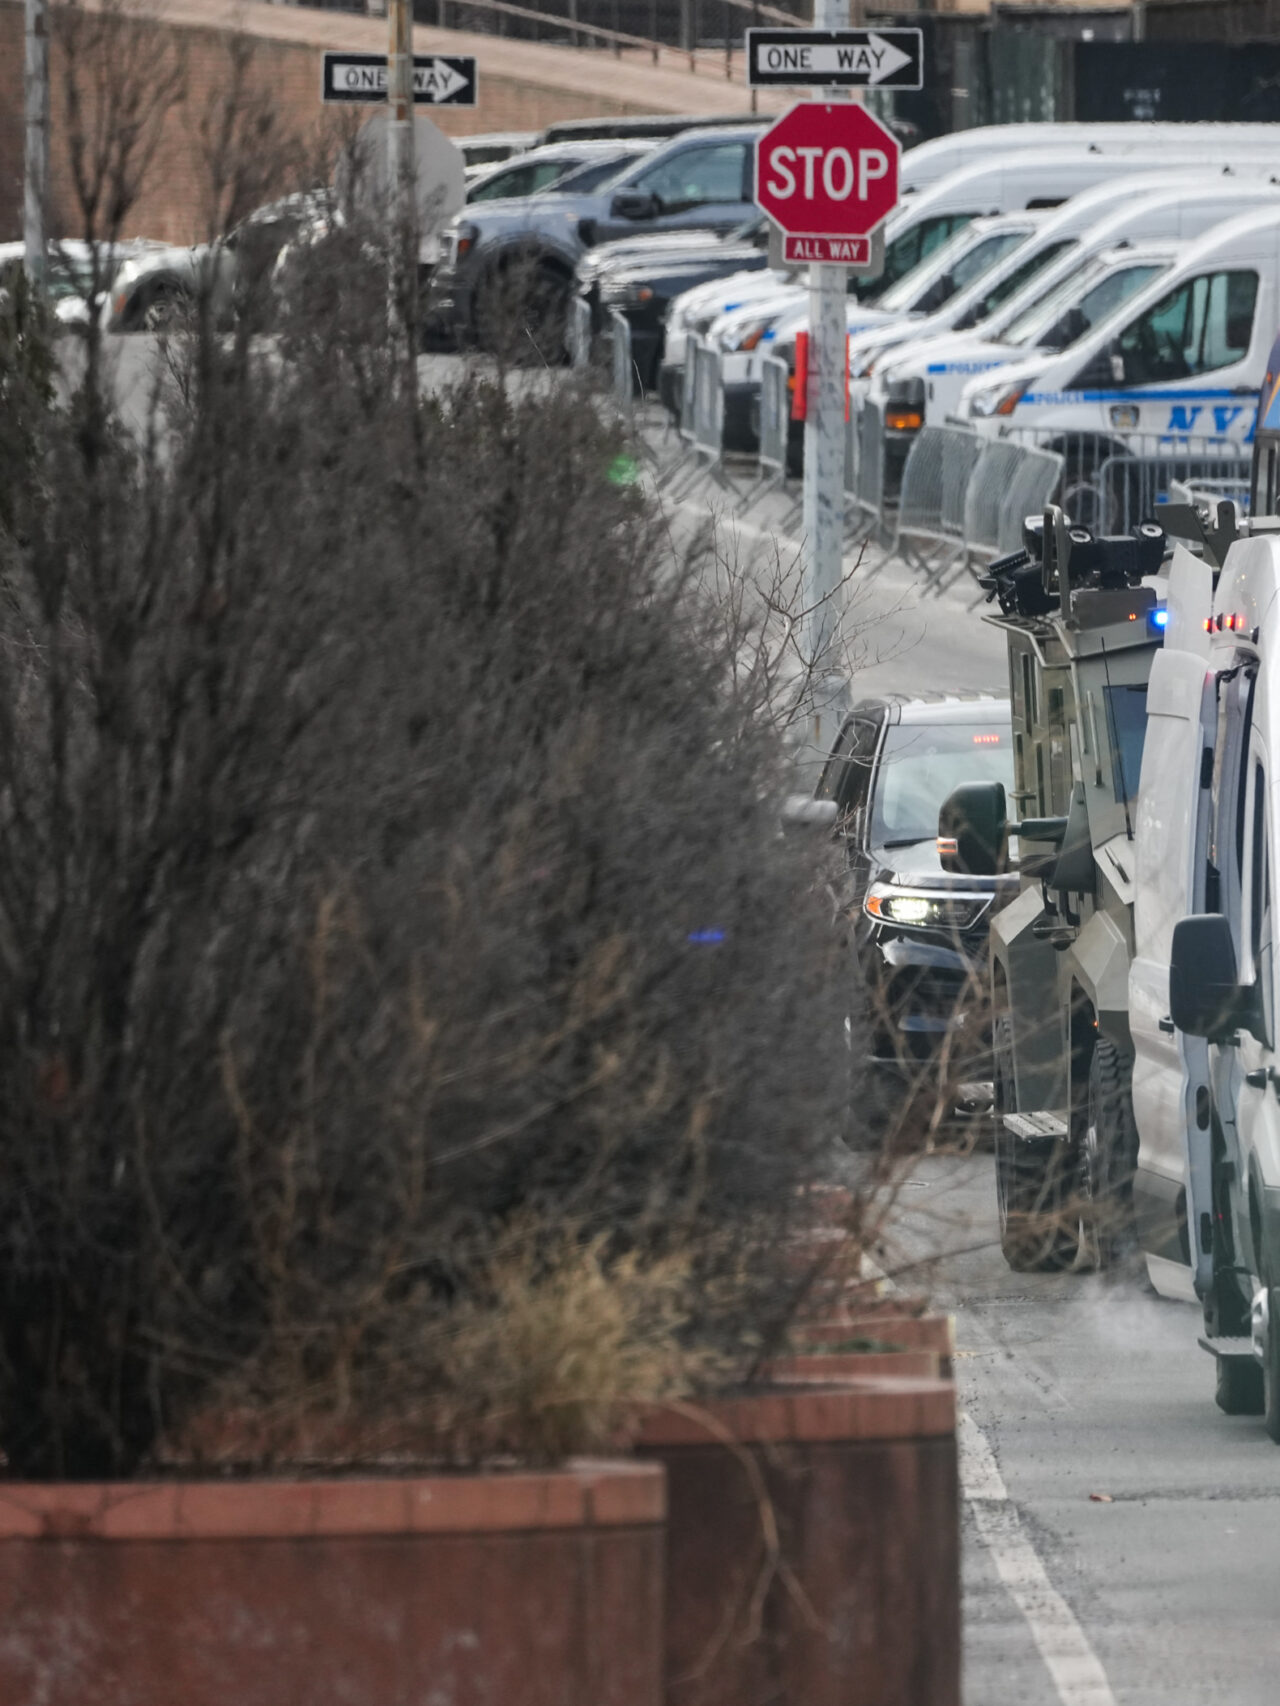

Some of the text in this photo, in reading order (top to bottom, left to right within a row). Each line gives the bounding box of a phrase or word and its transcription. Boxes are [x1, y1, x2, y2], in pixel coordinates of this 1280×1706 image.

[768, 48, 886, 69] ONE WAY
[346, 67, 388, 88] ONE
[767, 145, 889, 201] STOP
[794, 240, 860, 259] ALL WAY
